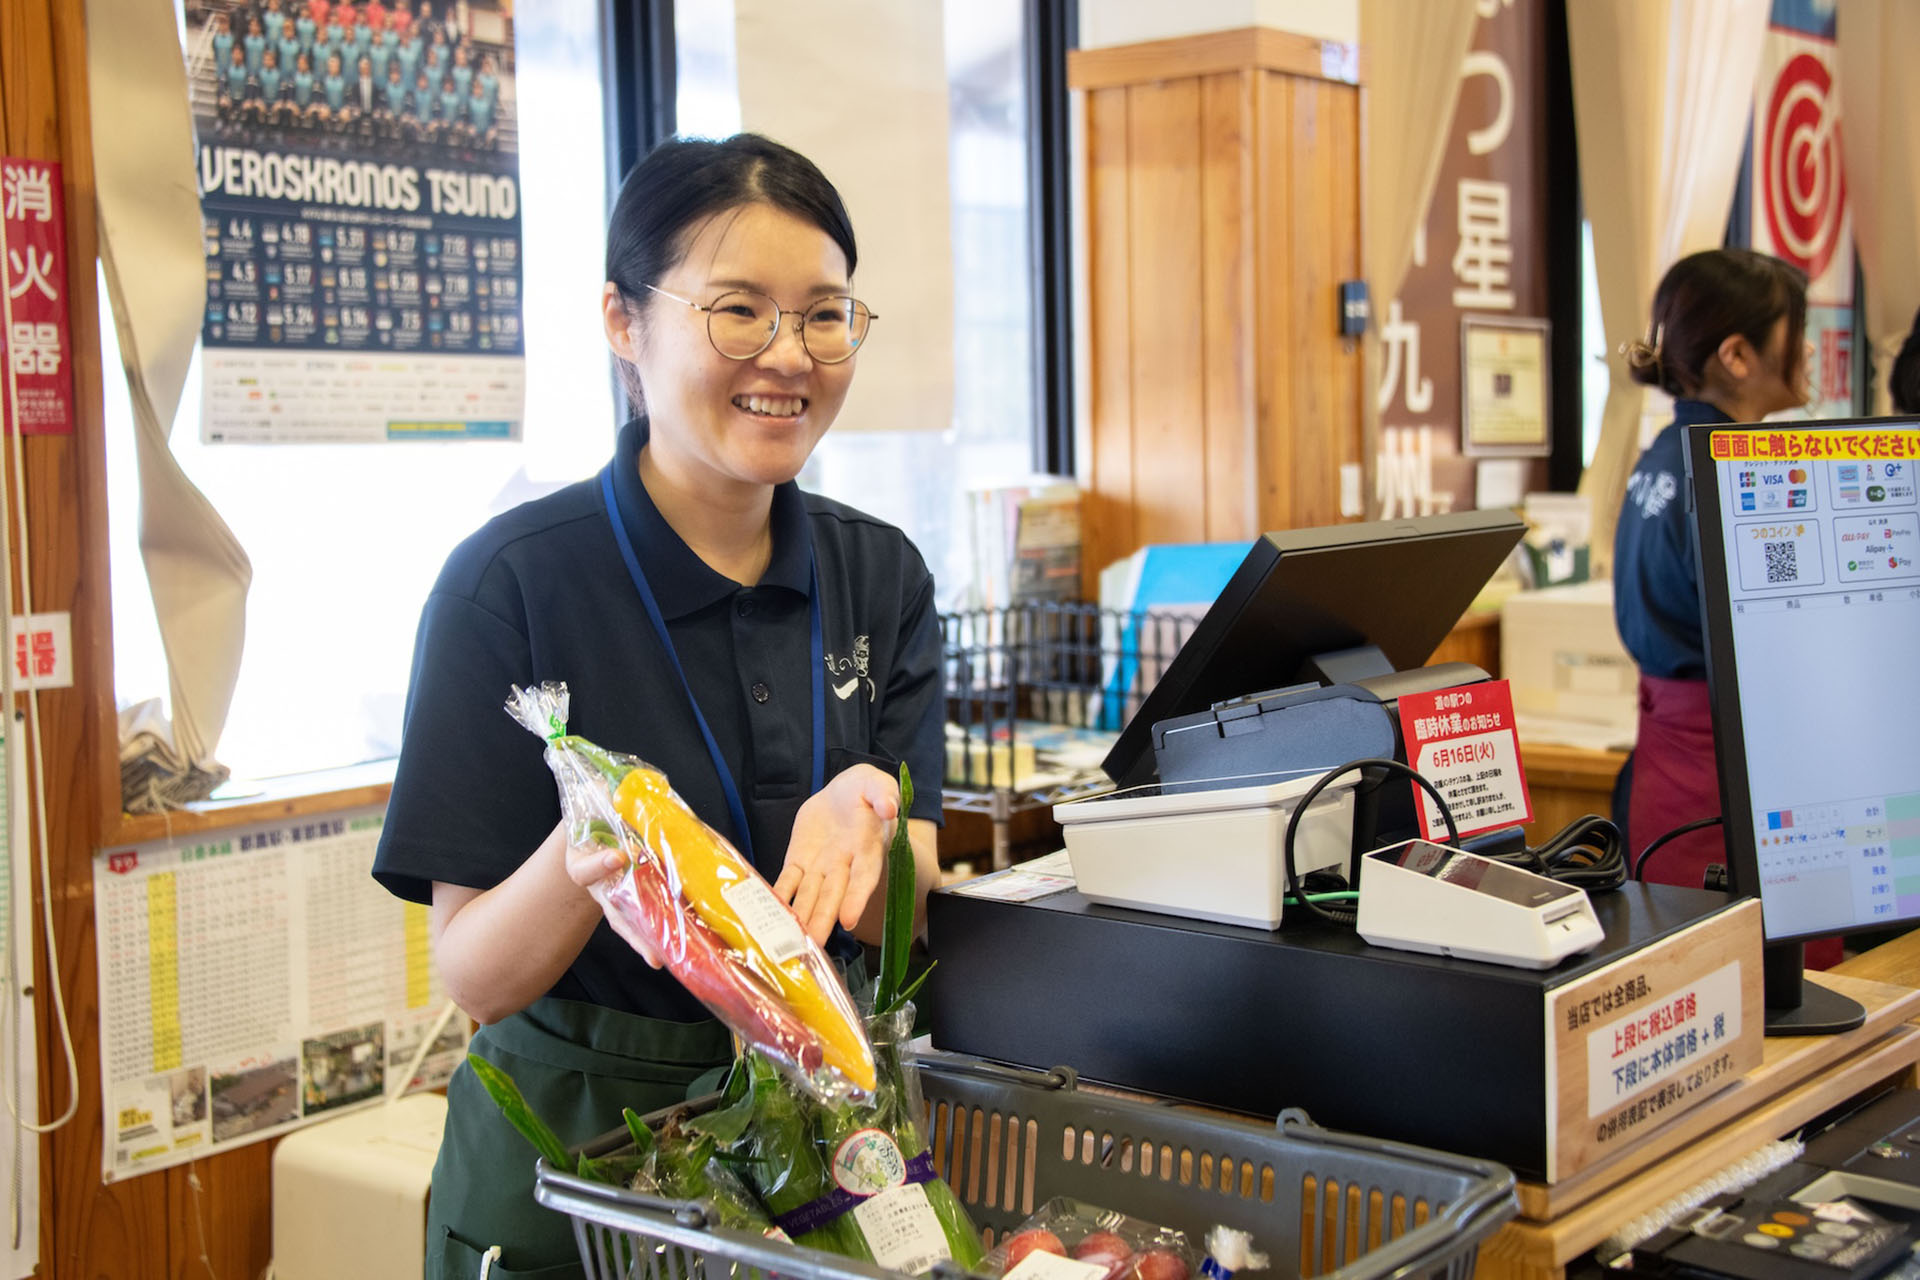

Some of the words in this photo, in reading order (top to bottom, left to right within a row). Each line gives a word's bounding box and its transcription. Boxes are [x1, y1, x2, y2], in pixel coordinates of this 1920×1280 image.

[202, 145, 419, 211] VEROSKRONOS
[425, 168, 516, 220] TSUNO
[4, 164, 61, 375] 消火器
[1712, 432, 1920, 458] 画面に触らないでください
[1763, 474, 1784, 485] VISA
[1751, 526, 1792, 539] つのコイン
[1434, 691, 1473, 711] 道の駅つの
[1413, 712, 1502, 741] 臨時休業のお知らせ
[1432, 741, 1496, 768] 6月16日(火)
[1567, 974, 1652, 1031] 当店では全商品、
[1611, 992, 1697, 1058] 上段に税込価格
[1612, 1028, 1698, 1095] 下段に本体価格
[1713, 1012, 1725, 1039] 税
